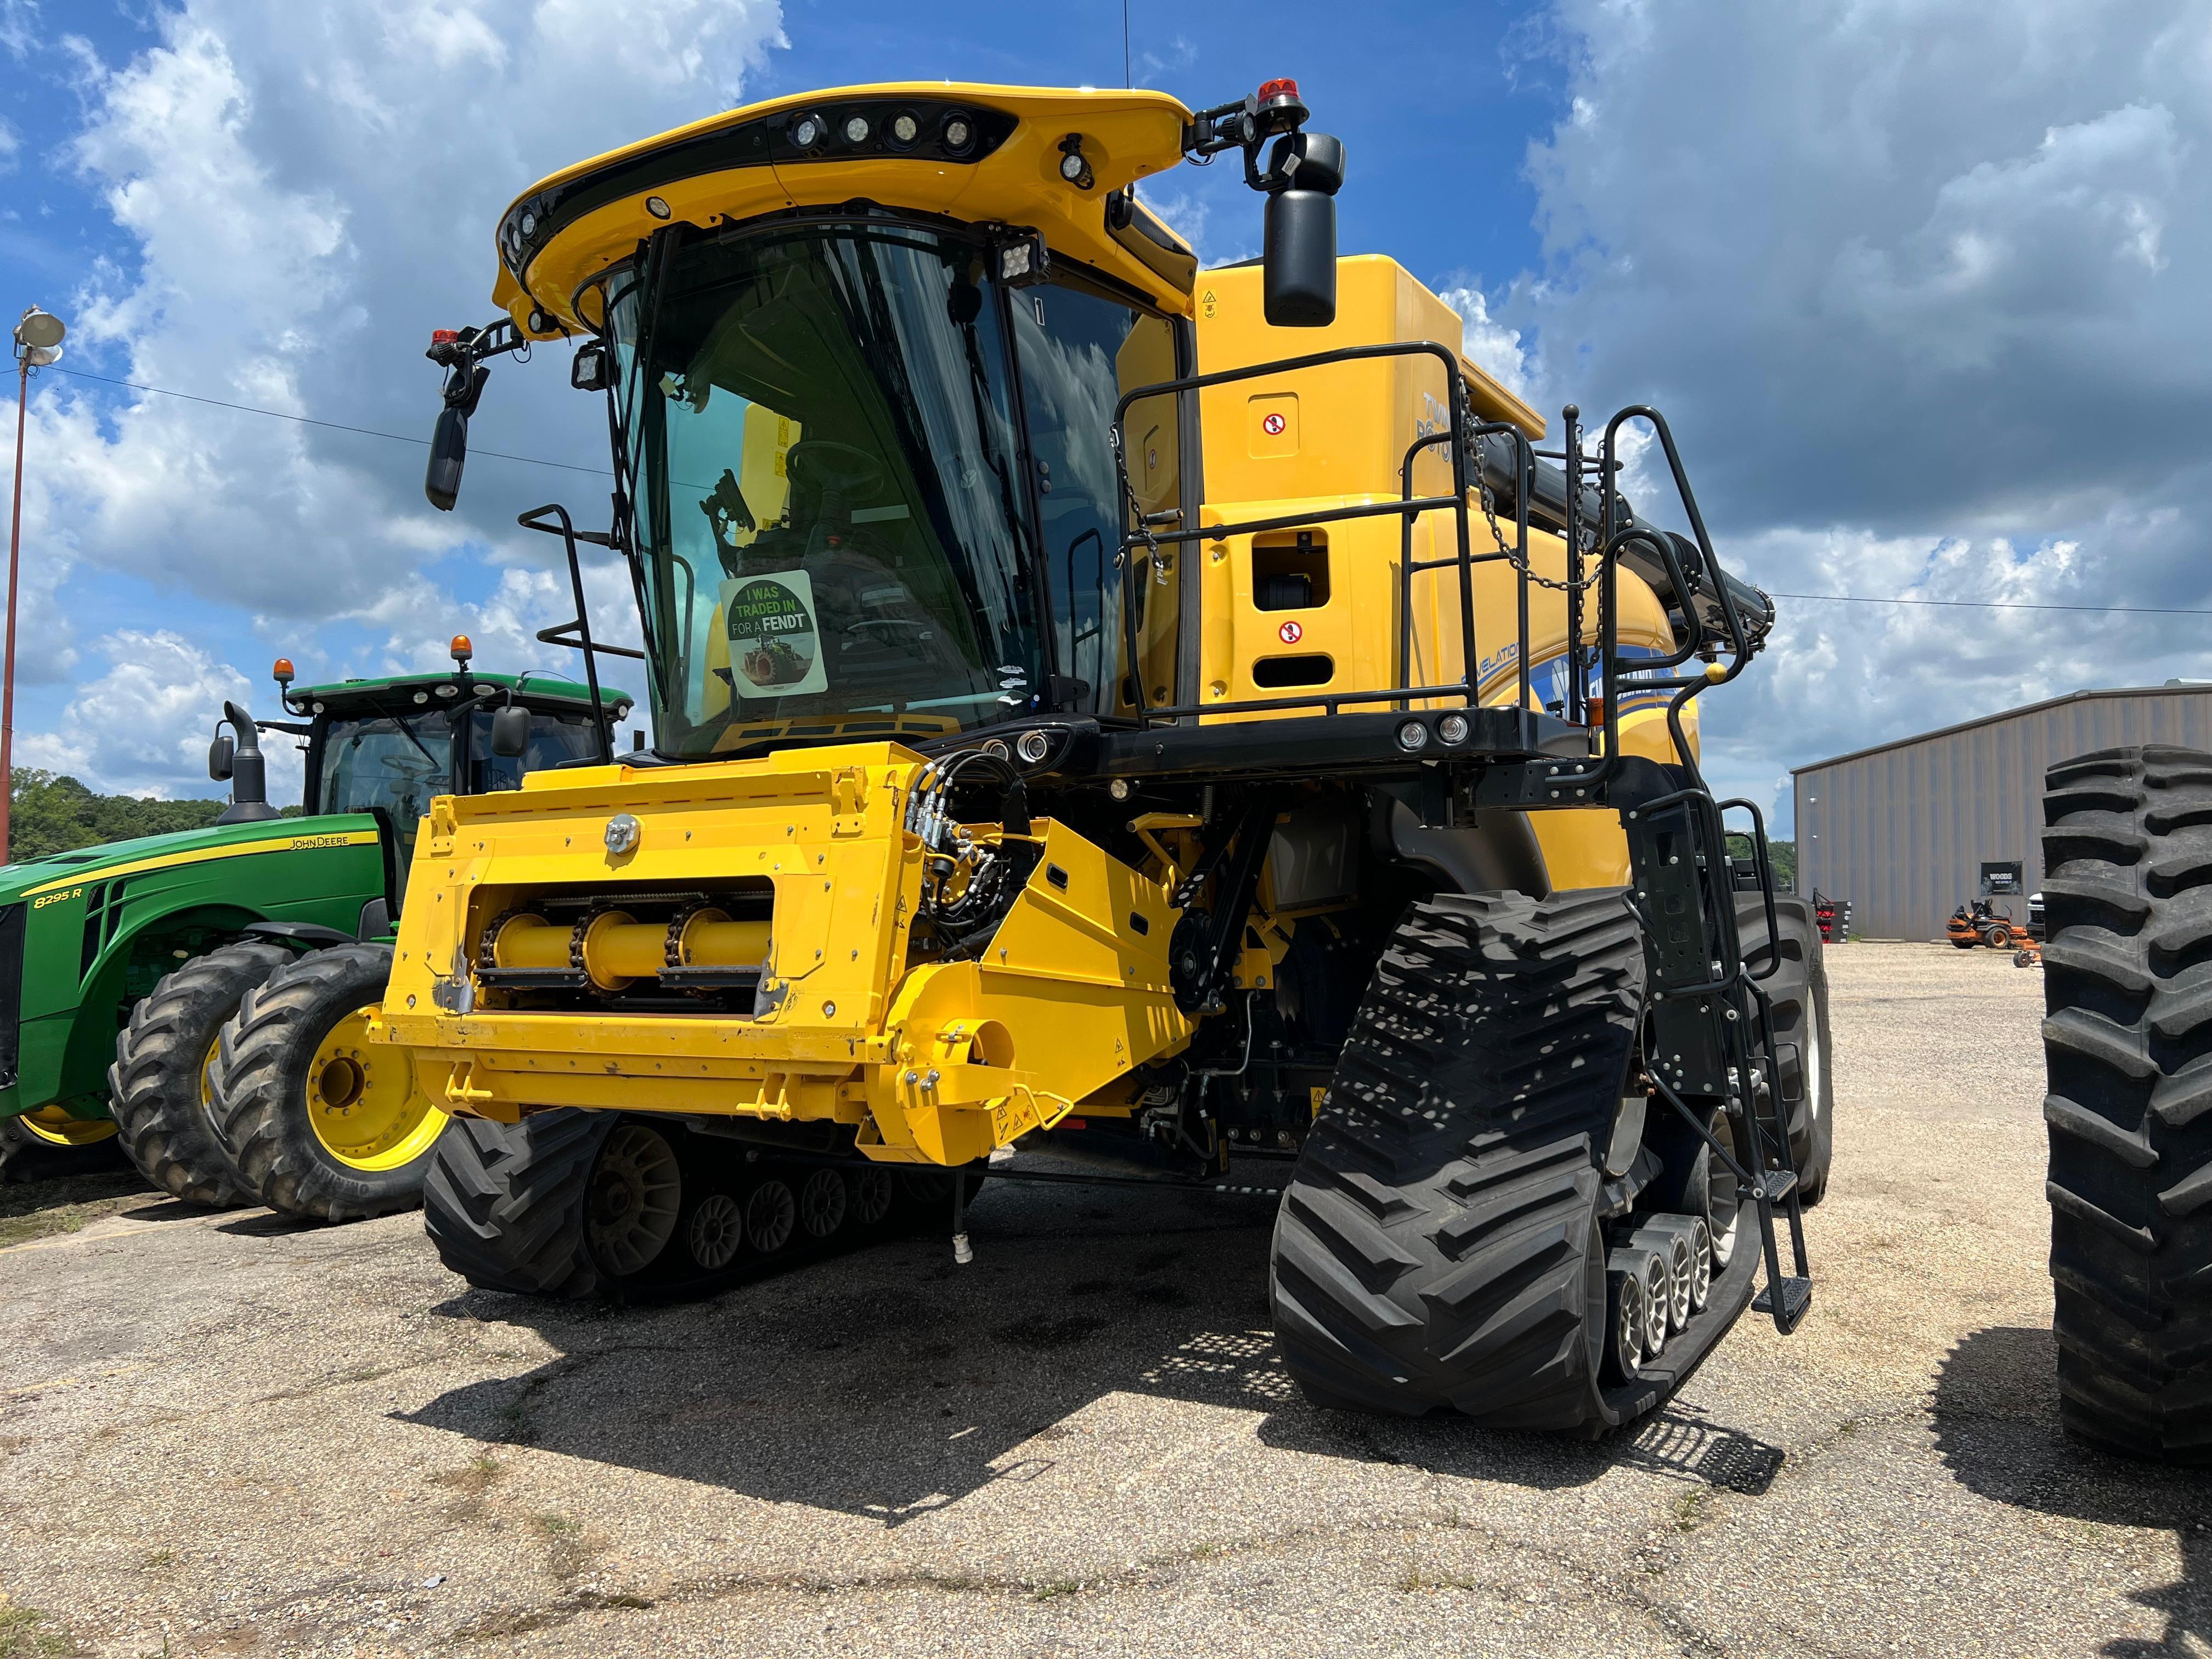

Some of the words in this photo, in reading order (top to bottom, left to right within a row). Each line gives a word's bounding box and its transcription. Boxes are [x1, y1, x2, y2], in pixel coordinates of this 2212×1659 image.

[747, 590, 751, 601] I
[753, 586, 778, 600] WAS
[736, 602, 781, 617] TRADED
[783, 600, 796, 612] IN
[732, 622, 752, 635] FOR
[755, 622, 761, 633] A
[763, 614, 804, 631] FENDT
[1461, 642, 1519, 685] VELATIO
[290, 838, 316, 849] JOHN
[317, 837, 348, 847] DEERE
[33, 891, 70, 909] 8295
[72, 888, 82, 899] R
